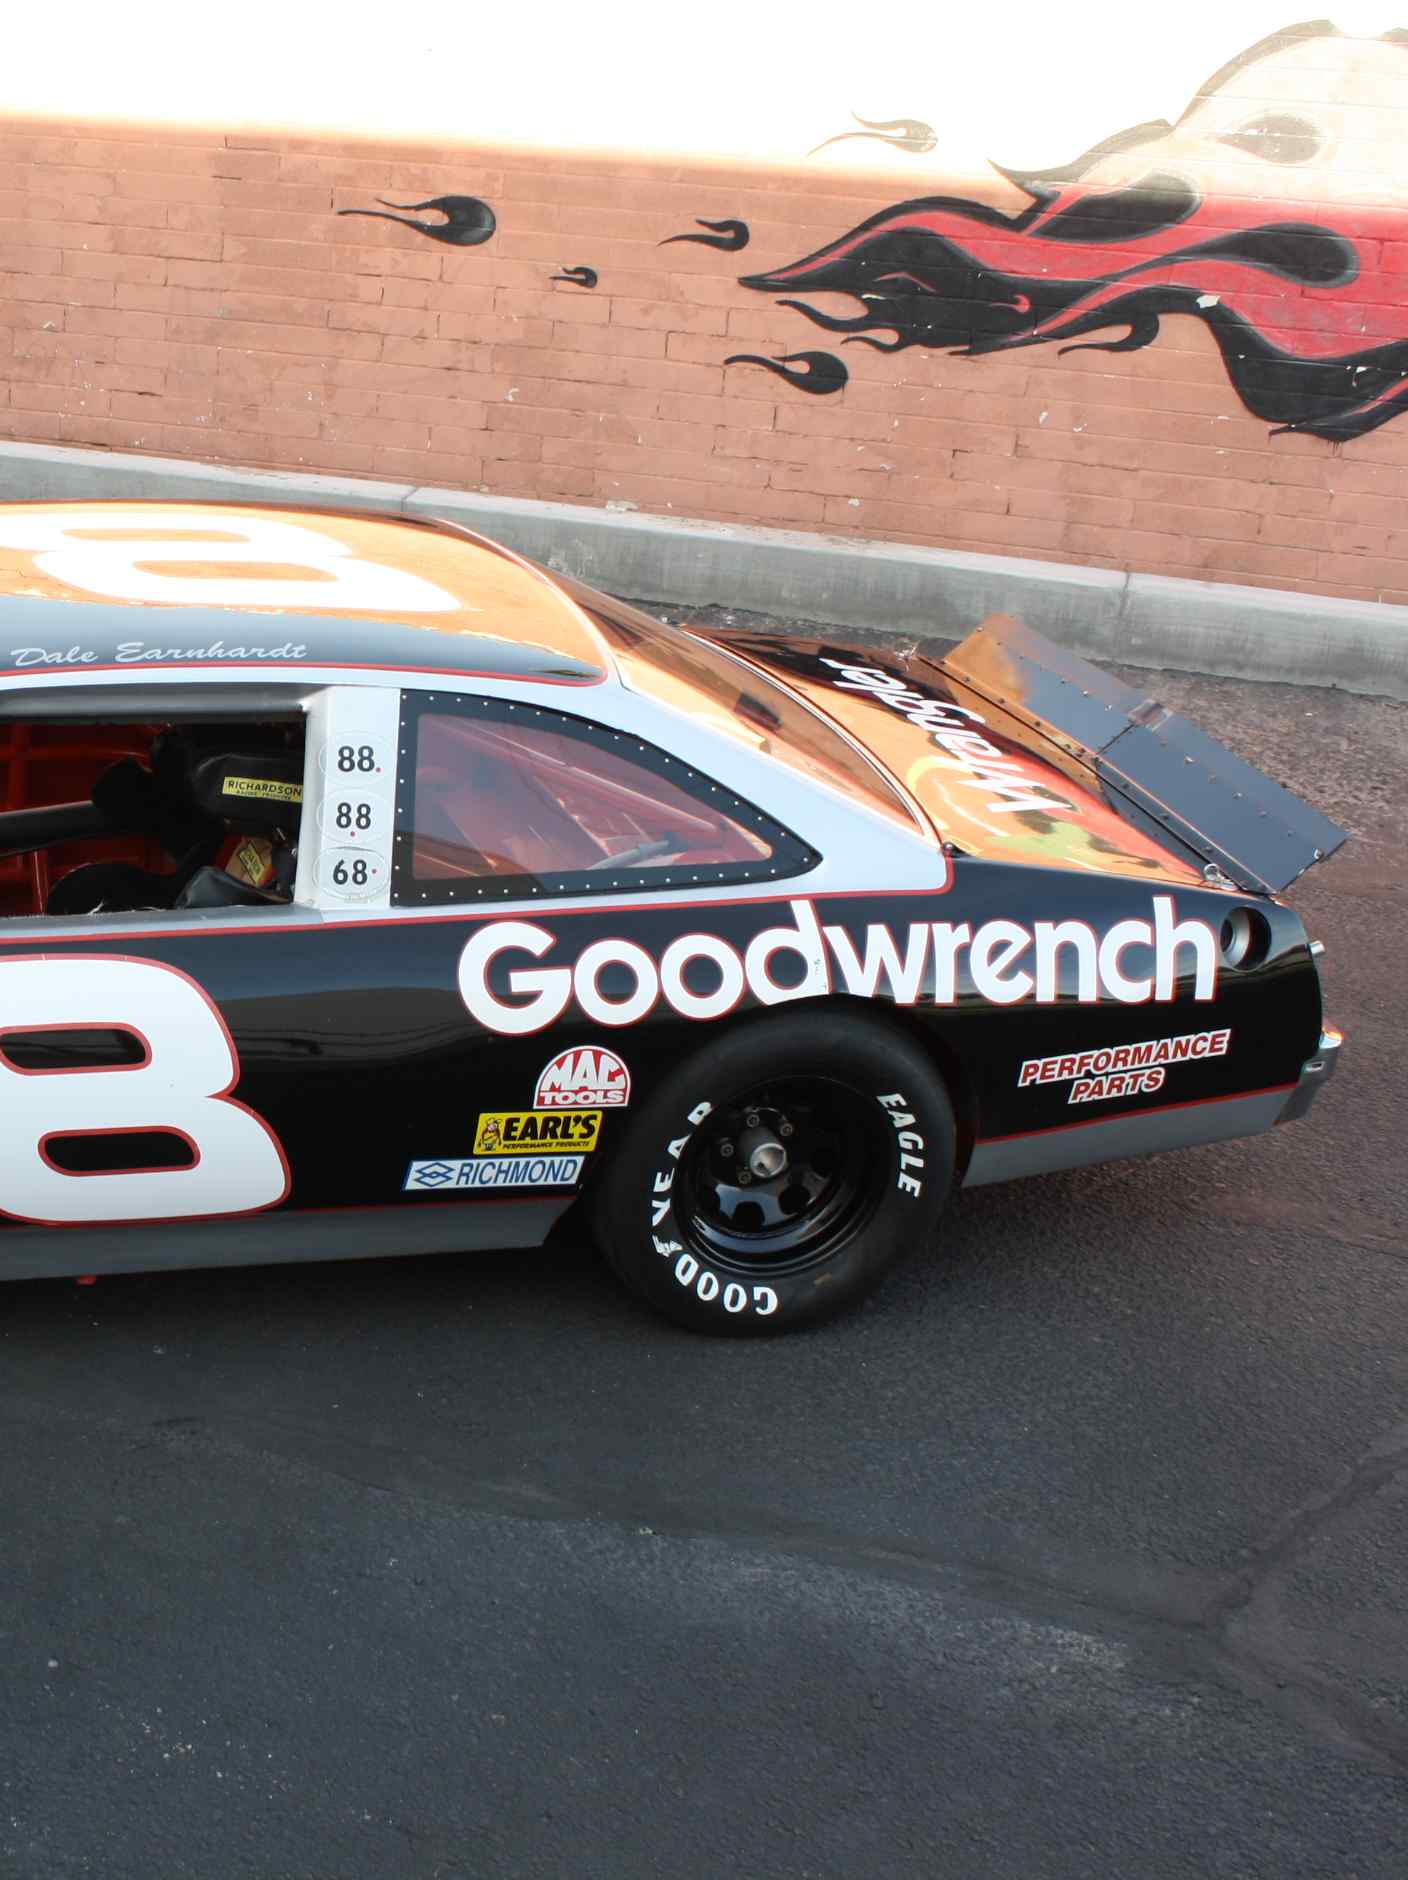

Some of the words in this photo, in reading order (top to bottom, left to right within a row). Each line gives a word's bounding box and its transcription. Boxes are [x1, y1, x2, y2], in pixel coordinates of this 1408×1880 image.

[10, 647, 99, 667] Dale
[114, 641, 308, 664] Earnhardt
[819, 657, 1072, 813] Wrangler
[337, 745, 375, 772] 88
[228, 780, 302, 796] RICHARDSON
[336, 802, 371, 829] 88
[333, 859, 368, 885] 68
[458, 897, 1219, 1035] Goodwrench
[540, 1050, 625, 1092] MAC
[1018, 1028, 1231, 1087] PERFORMANCE
[540, 1089, 624, 1105] TOOLS
[1068, 1067, 1164, 1104] PARTS
[502, 1115, 597, 1141] EARL'S
[502, 1141, 553, 1150] PERFORMANCE
[876, 1093, 924, 1197] EAGLE
[456, 1159, 578, 1185] RICHMOND
